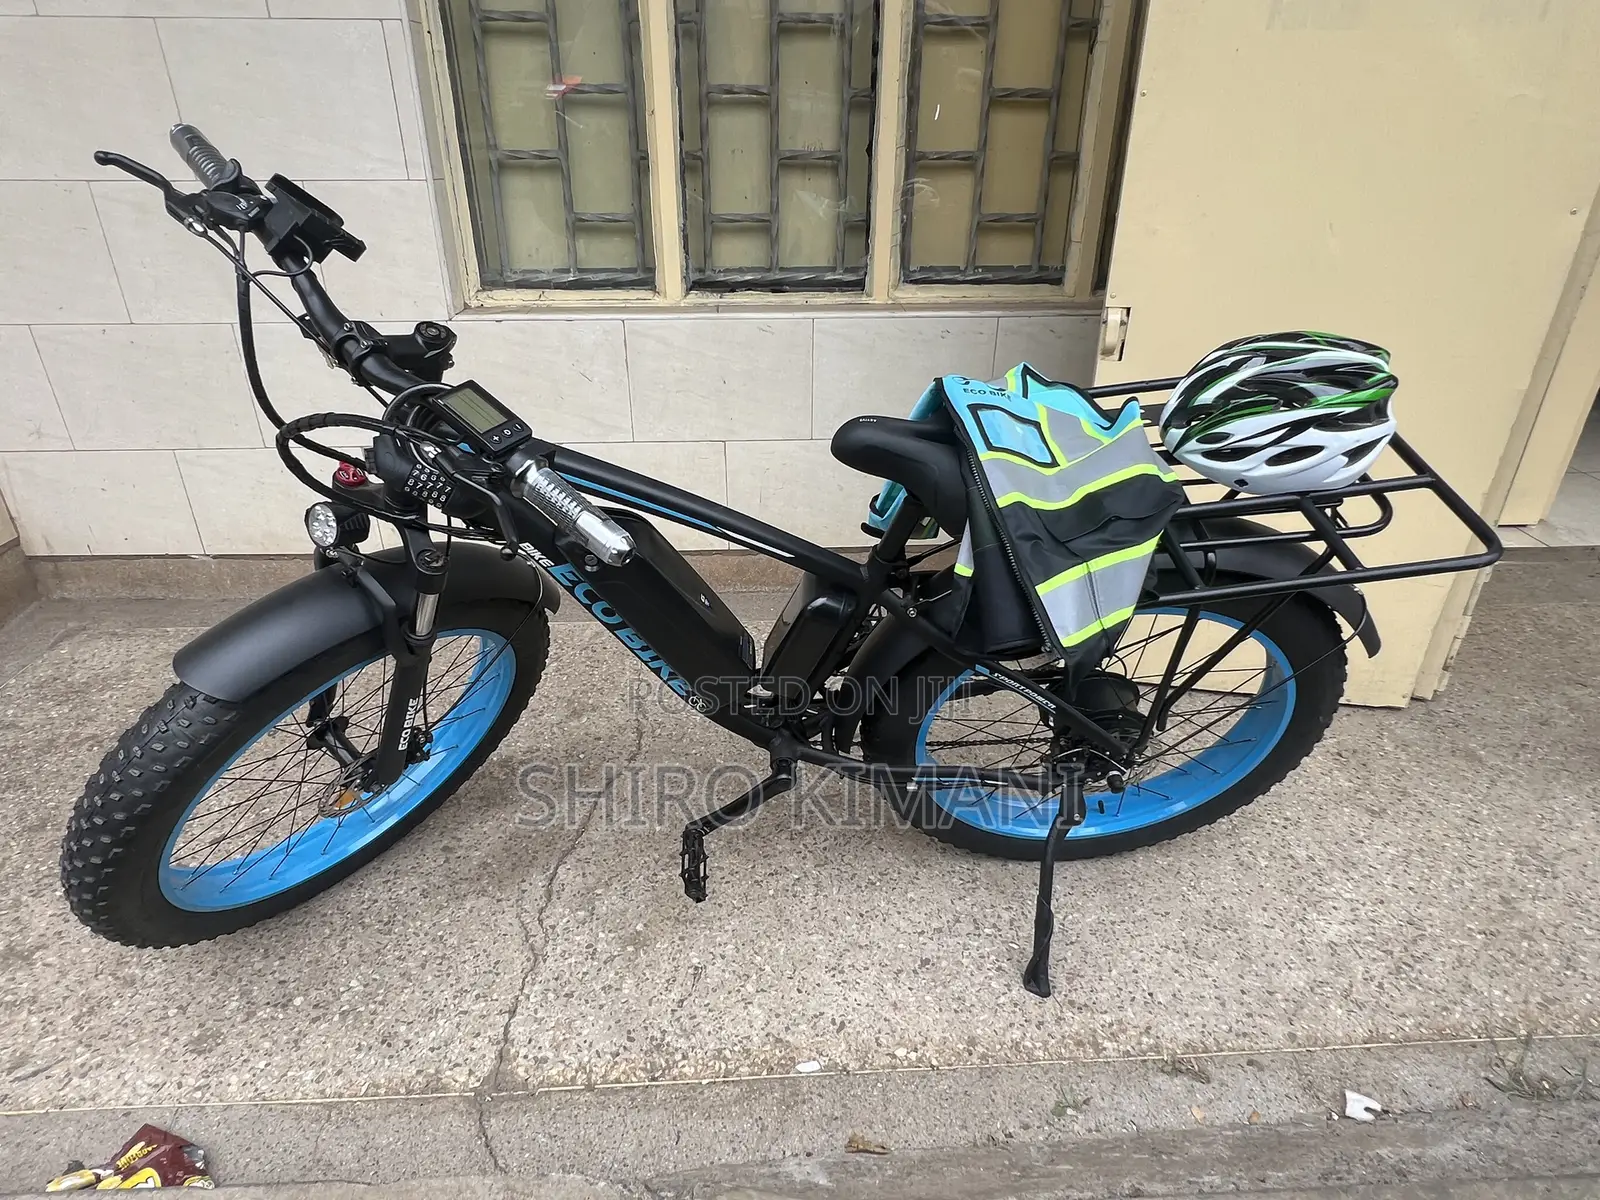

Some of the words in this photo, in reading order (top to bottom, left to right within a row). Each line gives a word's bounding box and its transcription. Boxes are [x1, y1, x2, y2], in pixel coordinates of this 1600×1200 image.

[426, 481, 434, 489] 7
[518, 542, 556, 567] BIKE
[548, 562, 624, 625] ECO
[614, 627, 689, 697] BIKE
[403, 697, 419, 728] BIKE
[398, 728, 411, 751] ECO
